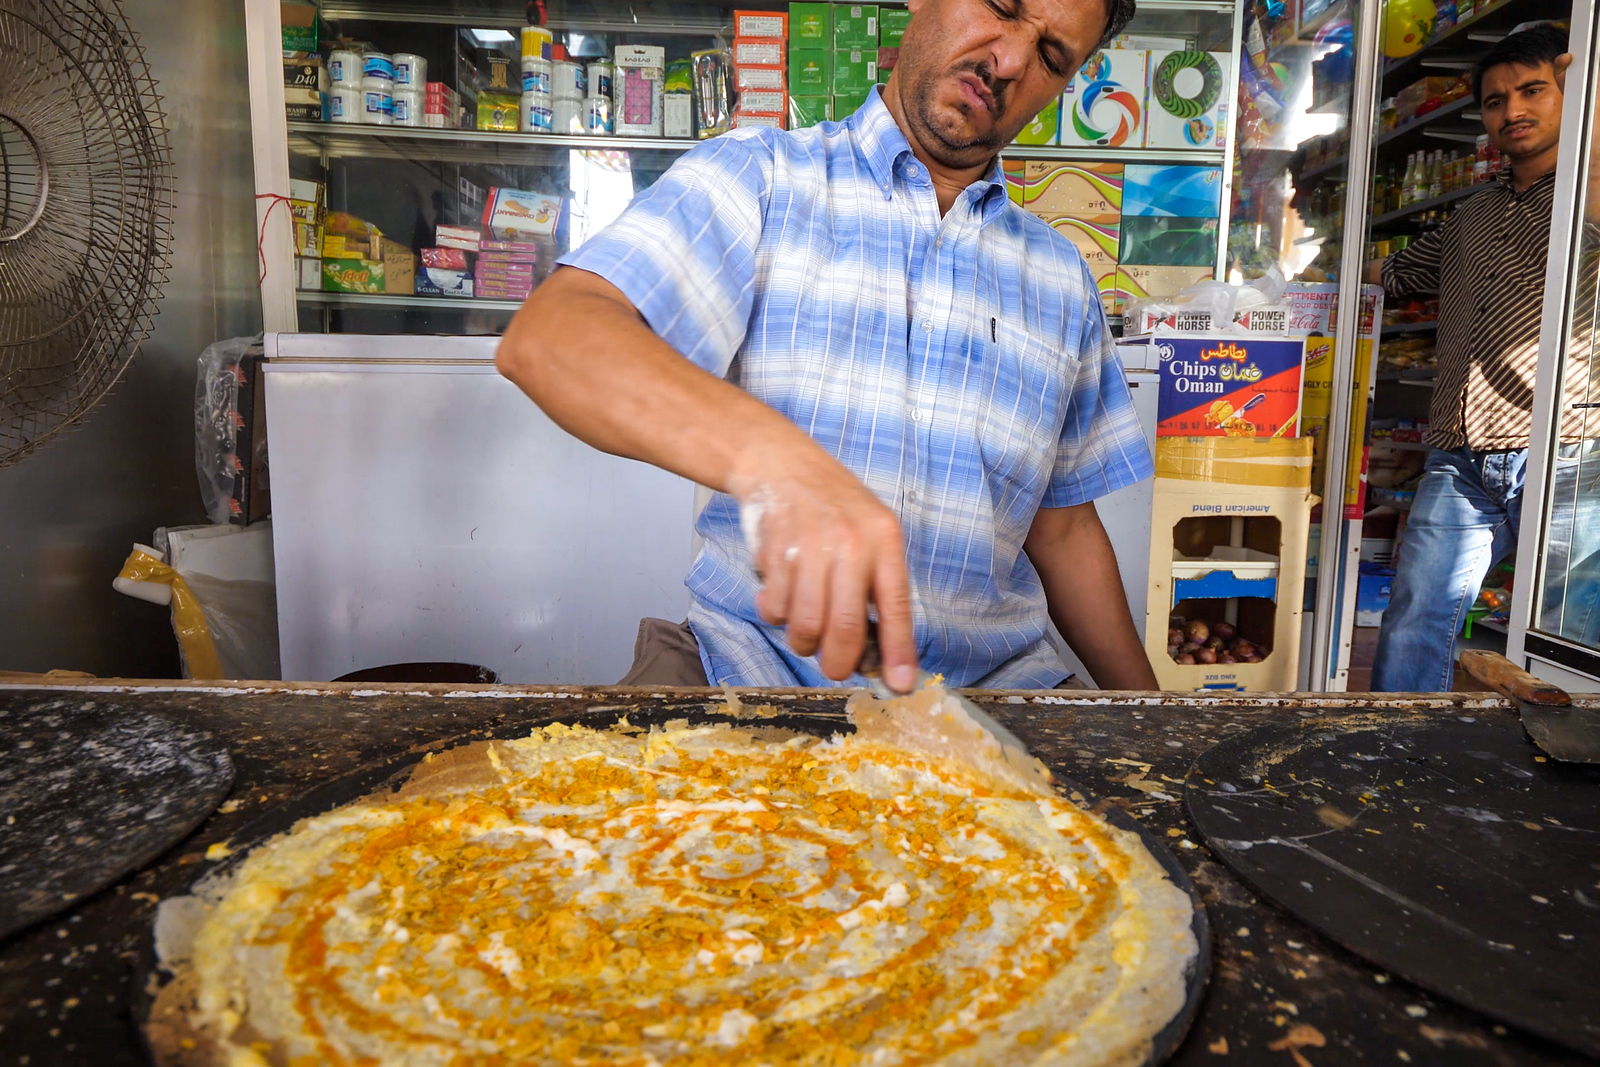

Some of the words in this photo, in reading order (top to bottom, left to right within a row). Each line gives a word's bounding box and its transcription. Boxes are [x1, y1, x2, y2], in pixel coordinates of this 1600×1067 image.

[295, 75, 316, 85] D40
[1177, 311, 1211, 321] POWER
[1251, 310, 1285, 321] POWER
[1177, 321, 1211, 331] HORSE
[1251, 321, 1285, 331] HORSE
[1201, 343, 1247, 362] بطاطس
[1169, 360, 1217, 380] Chips
[1175, 377, 1224, 393] Oman
[1192, 504, 1223, 514] Blend
[1225, 504, 1271, 513] American
